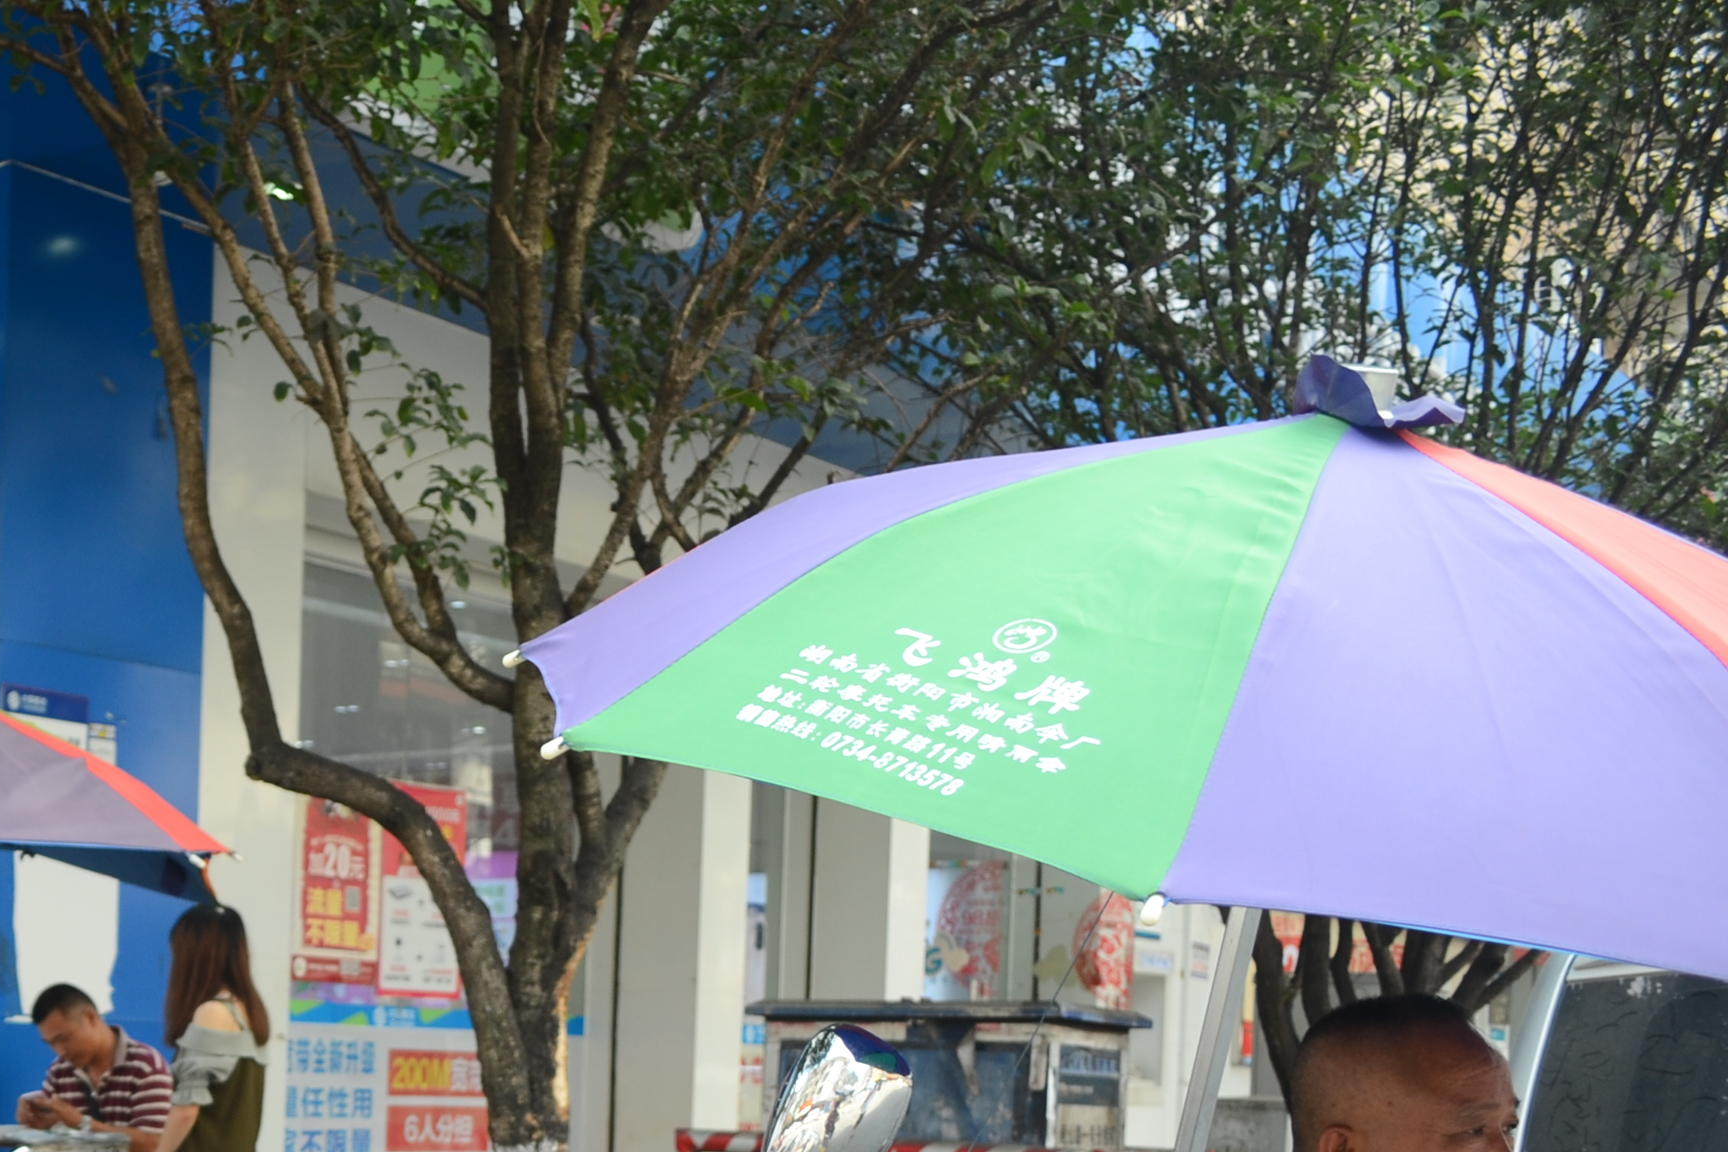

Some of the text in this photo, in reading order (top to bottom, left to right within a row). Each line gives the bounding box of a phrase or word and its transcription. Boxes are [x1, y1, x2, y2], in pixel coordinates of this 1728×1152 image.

[895, 627, 1091, 714] 飞鸿牌
[288, 1038, 375, 1074] 带全新升级
